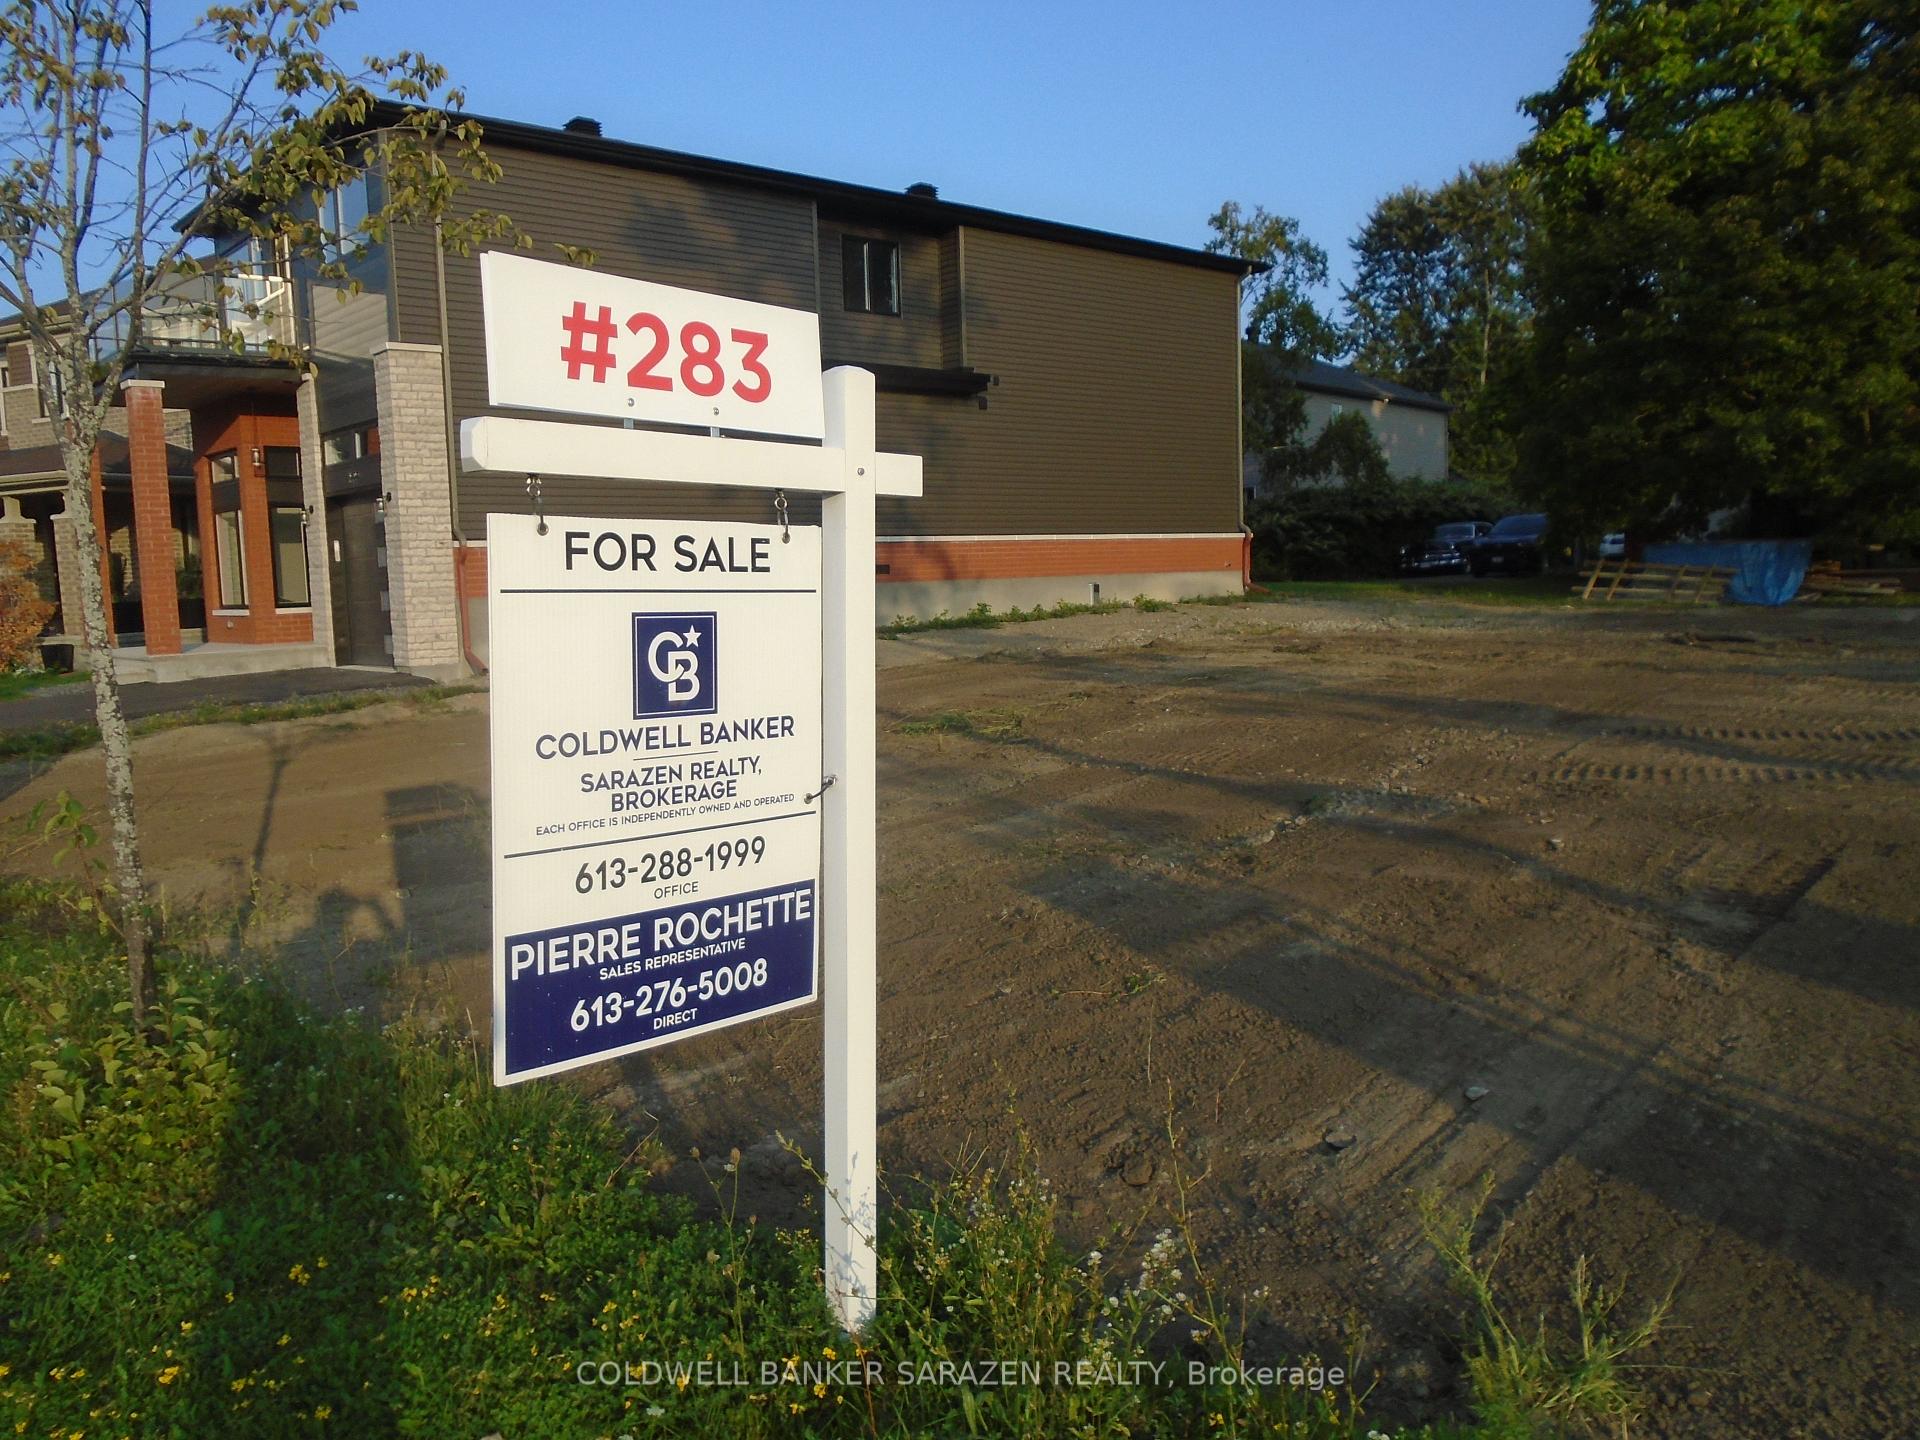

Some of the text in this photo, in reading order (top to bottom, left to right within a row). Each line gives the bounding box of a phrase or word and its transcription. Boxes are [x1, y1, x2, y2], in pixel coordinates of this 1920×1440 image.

[560, 300, 772, 403] #283
[565, 531, 771, 573] FOR SALE
[535, 715, 795, 760] COLDWELL BANKER
[580, 755, 762, 794] SARAZEN REALTY,
[536, 793, 795, 836] EACH OFFICE IS INDEPENDENTLY OWNED AND OPERATED
[611, 780, 737, 813] BROKERAGE
[575, 835, 766, 894] 613-288-1999
[653, 881, 699, 900] OFFICE
[511, 888, 811, 981] PIERRE ROCHETTE
[599, 937, 746, 981] SALES REPRESENTATIVE
[570, 957, 768, 1032] 613-276-5008
[653, 1008, 698, 1030] DIRECT
